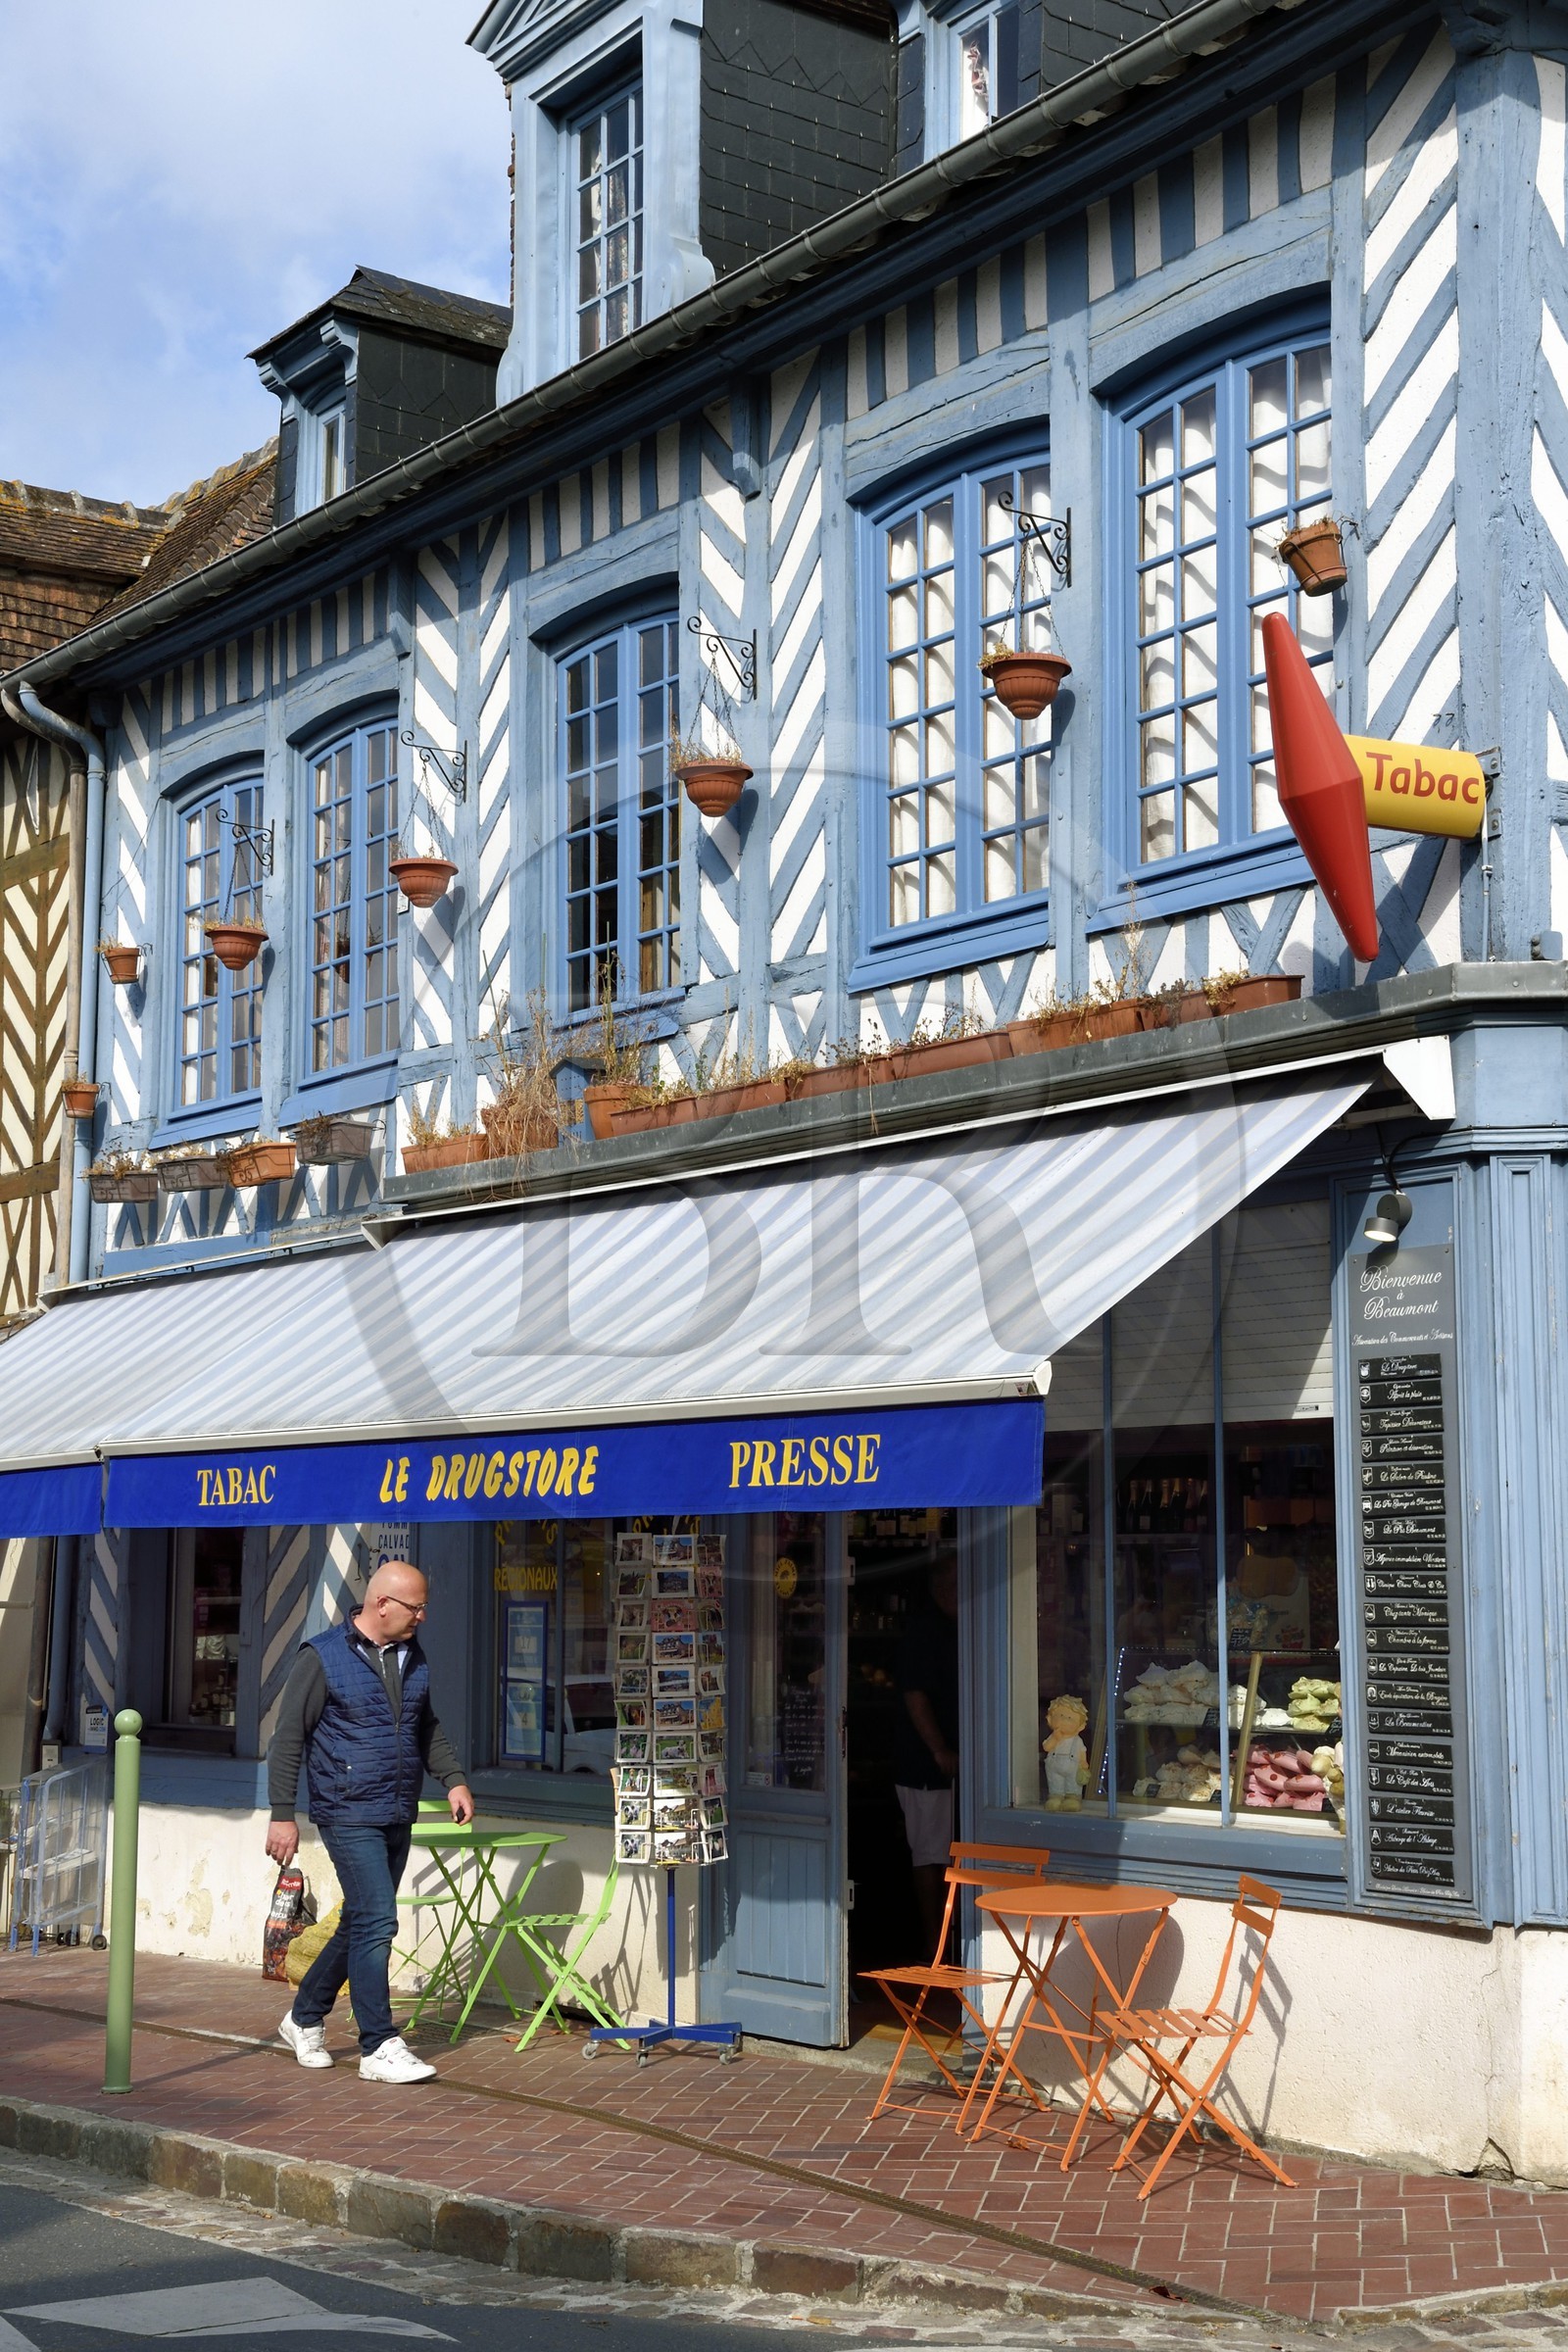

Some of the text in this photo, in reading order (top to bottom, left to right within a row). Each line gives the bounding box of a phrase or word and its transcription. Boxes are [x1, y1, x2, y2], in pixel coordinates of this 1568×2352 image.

[1365, 751, 1480, 805] Tabac
[1359, 1264, 1443, 1293] Bienvenue
[1396, 1289, 1404, 1300] à
[1363, 1296, 1440, 1320] Beaumont
[379, 1446, 599, 1503] LE DRUGSTORE
[728, 1434, 881, 1488] PRESSE
[197, 1464, 276, 1506] TABAC
